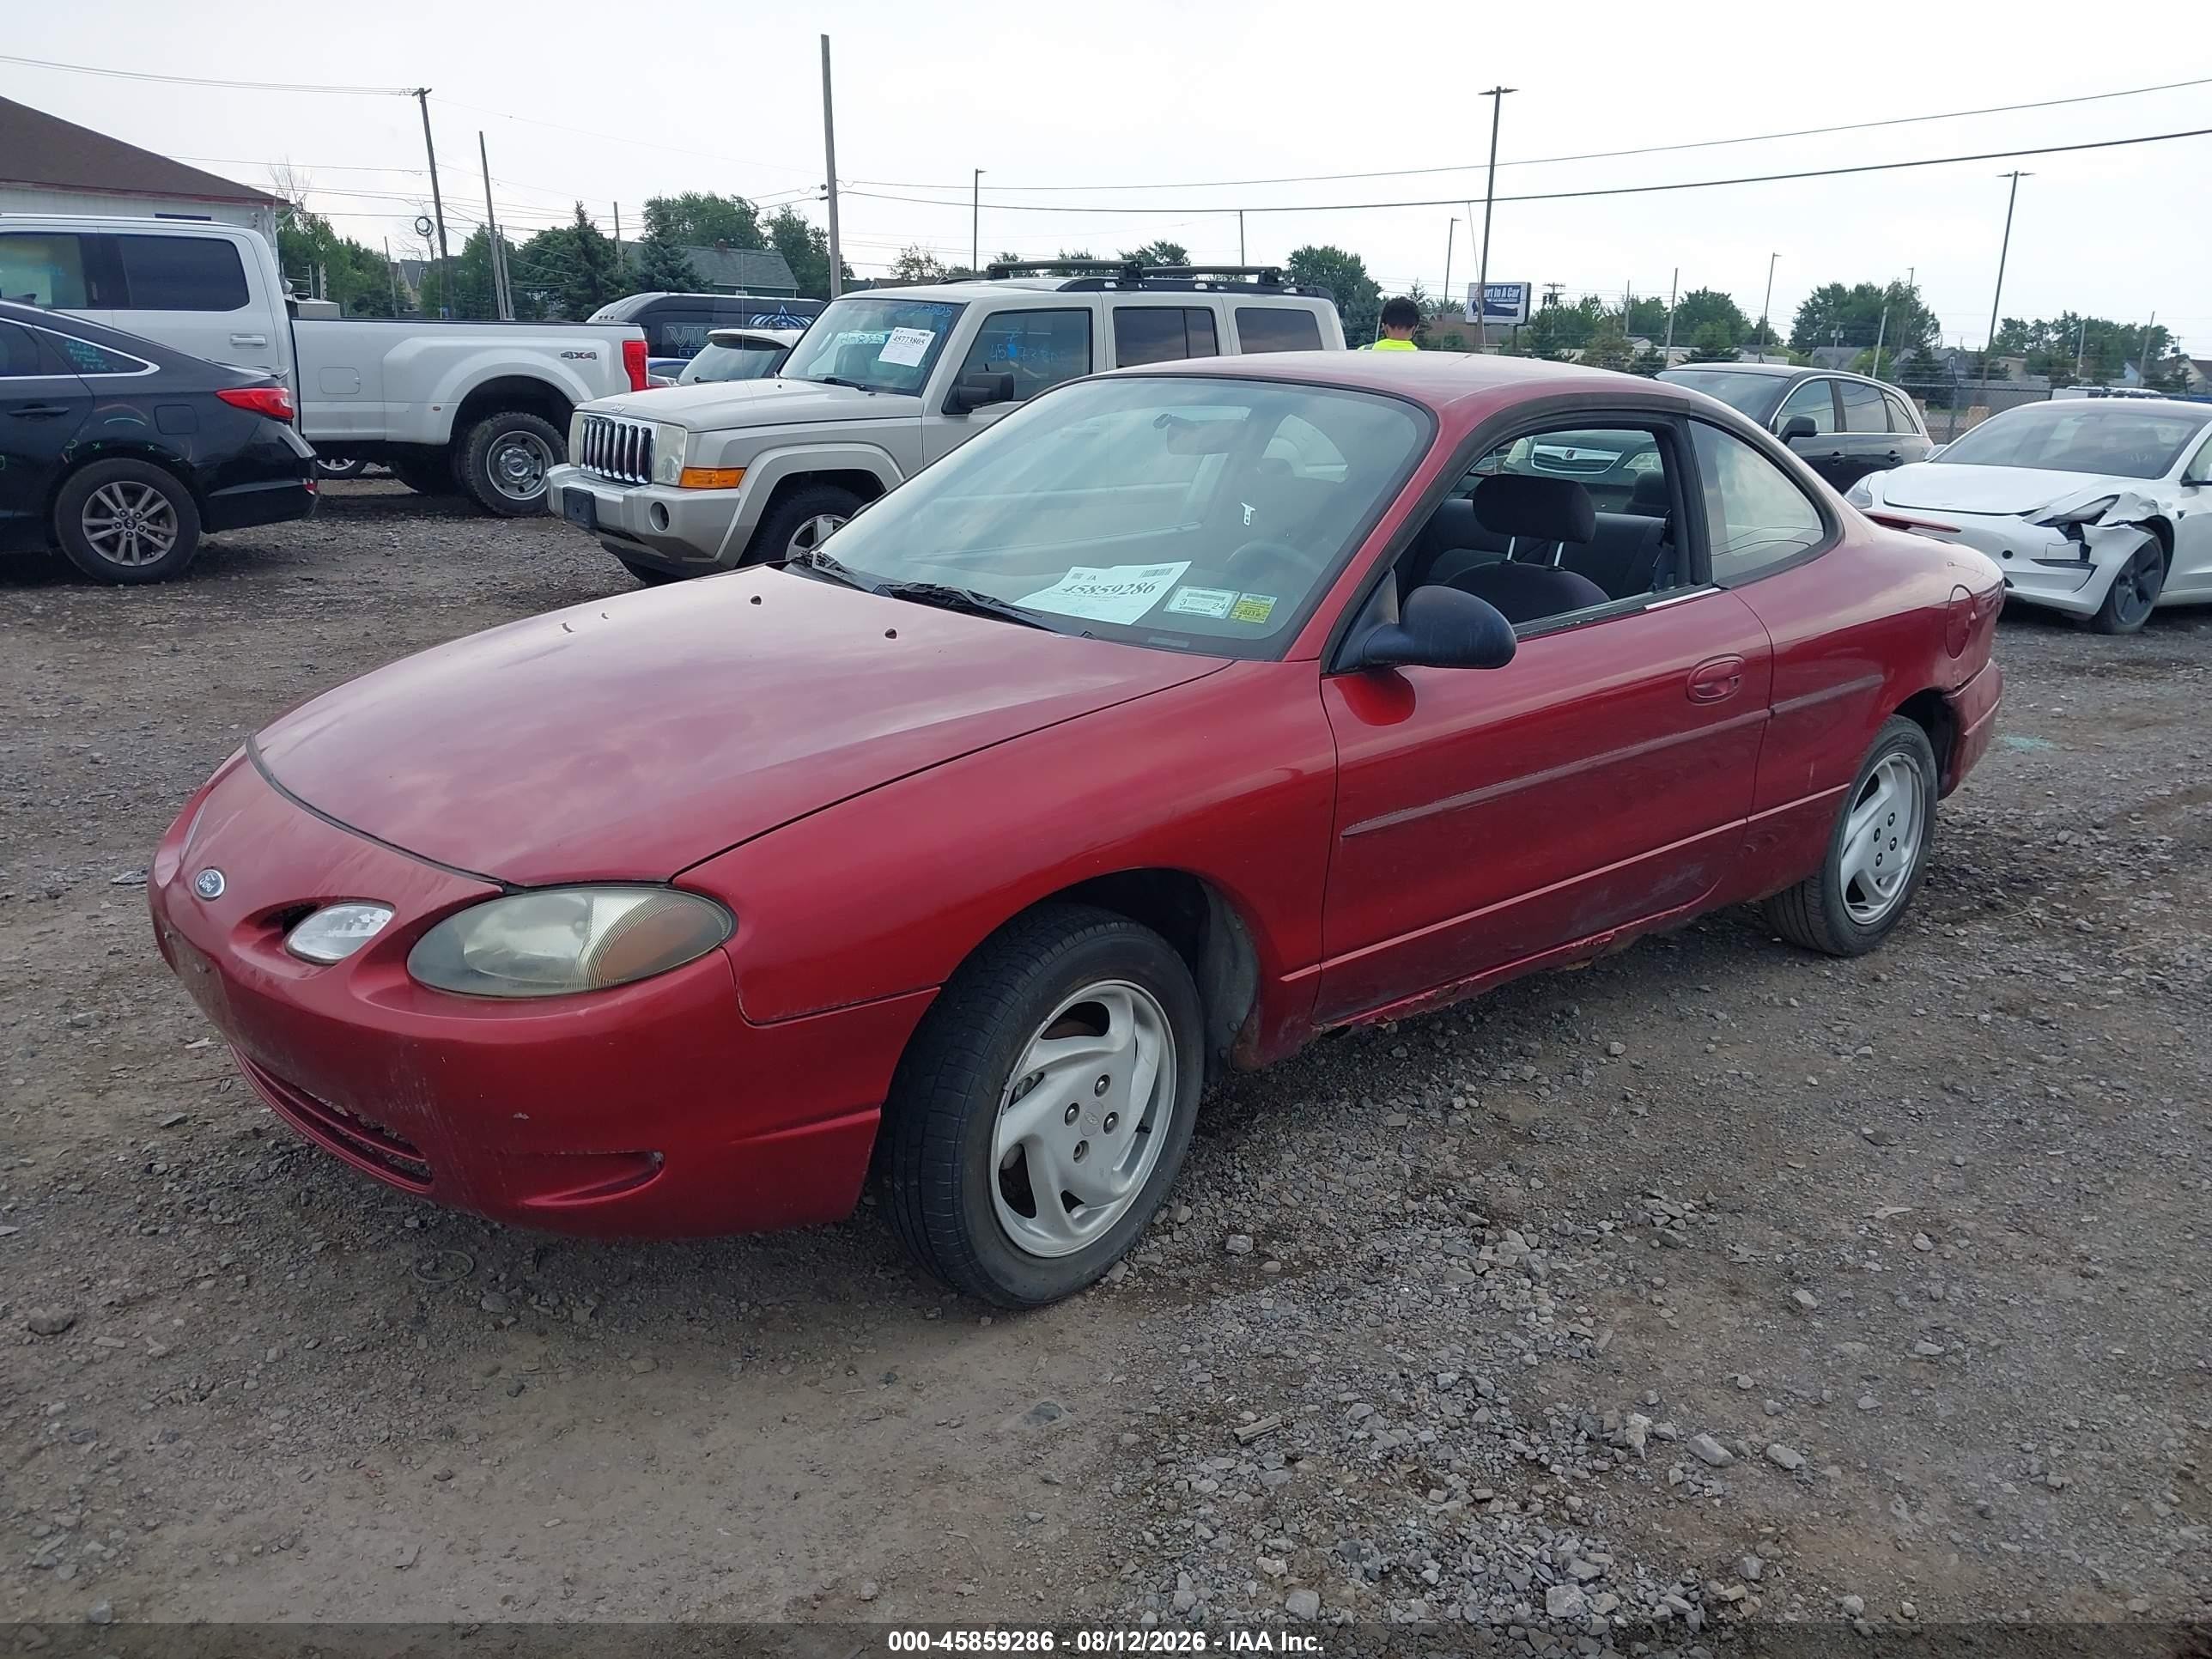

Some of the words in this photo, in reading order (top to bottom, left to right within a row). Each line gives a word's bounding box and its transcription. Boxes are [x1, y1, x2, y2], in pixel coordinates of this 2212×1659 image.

[1502, 287, 1507, 298] A
[1507, 287, 1521, 298] Car
[892, 334, 926, 346] 45773805
[1061, 580, 1161, 596] 45859286
[1211, 602, 1226, 611] 24
